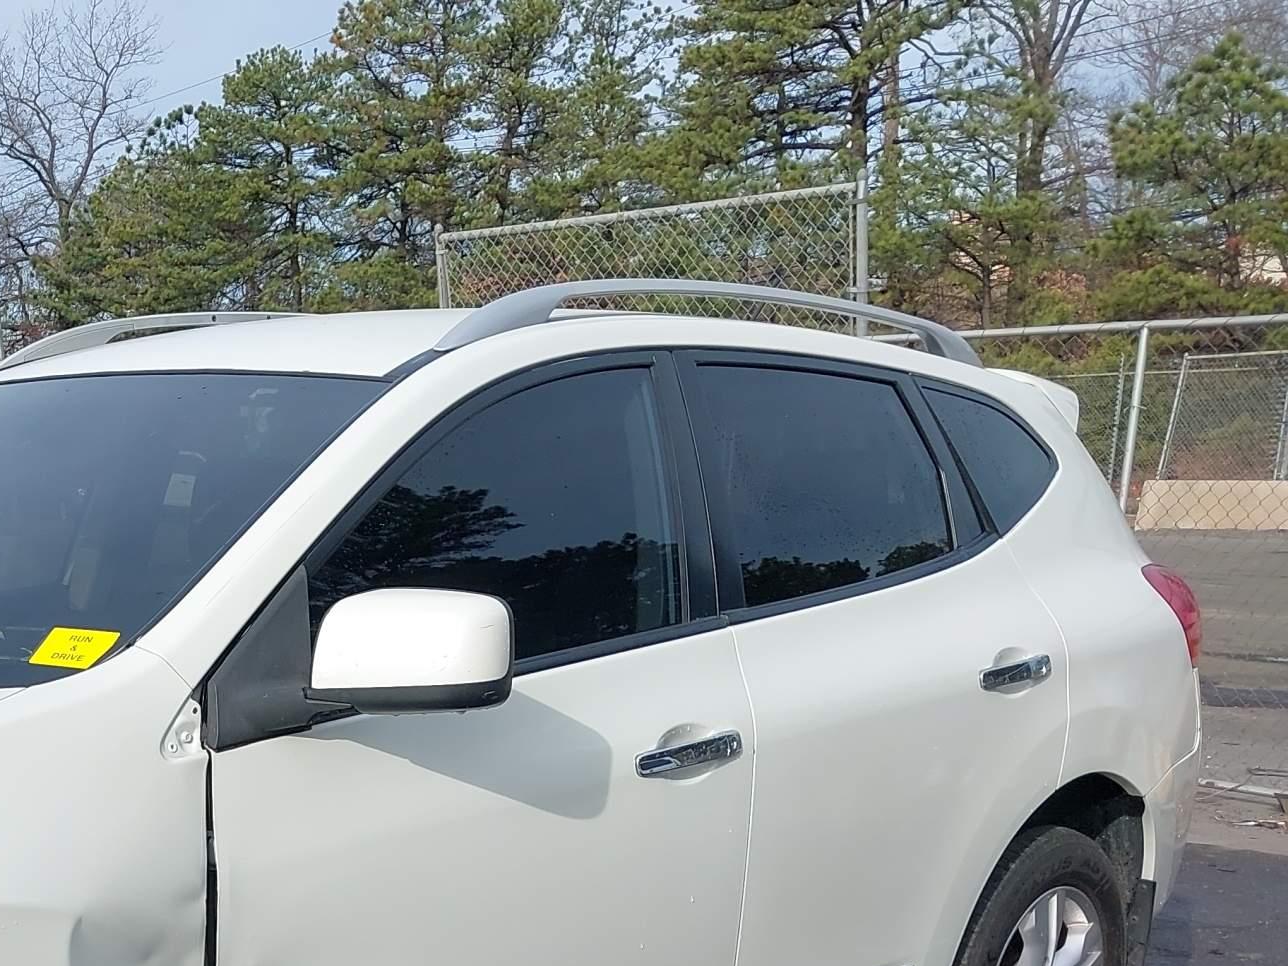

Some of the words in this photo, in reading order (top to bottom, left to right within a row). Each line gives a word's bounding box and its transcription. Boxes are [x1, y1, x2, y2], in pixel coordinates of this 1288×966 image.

[68, 635, 94, 643] RUN
[69, 644, 78, 652] &
[51, 652, 86, 662] DRIVE
